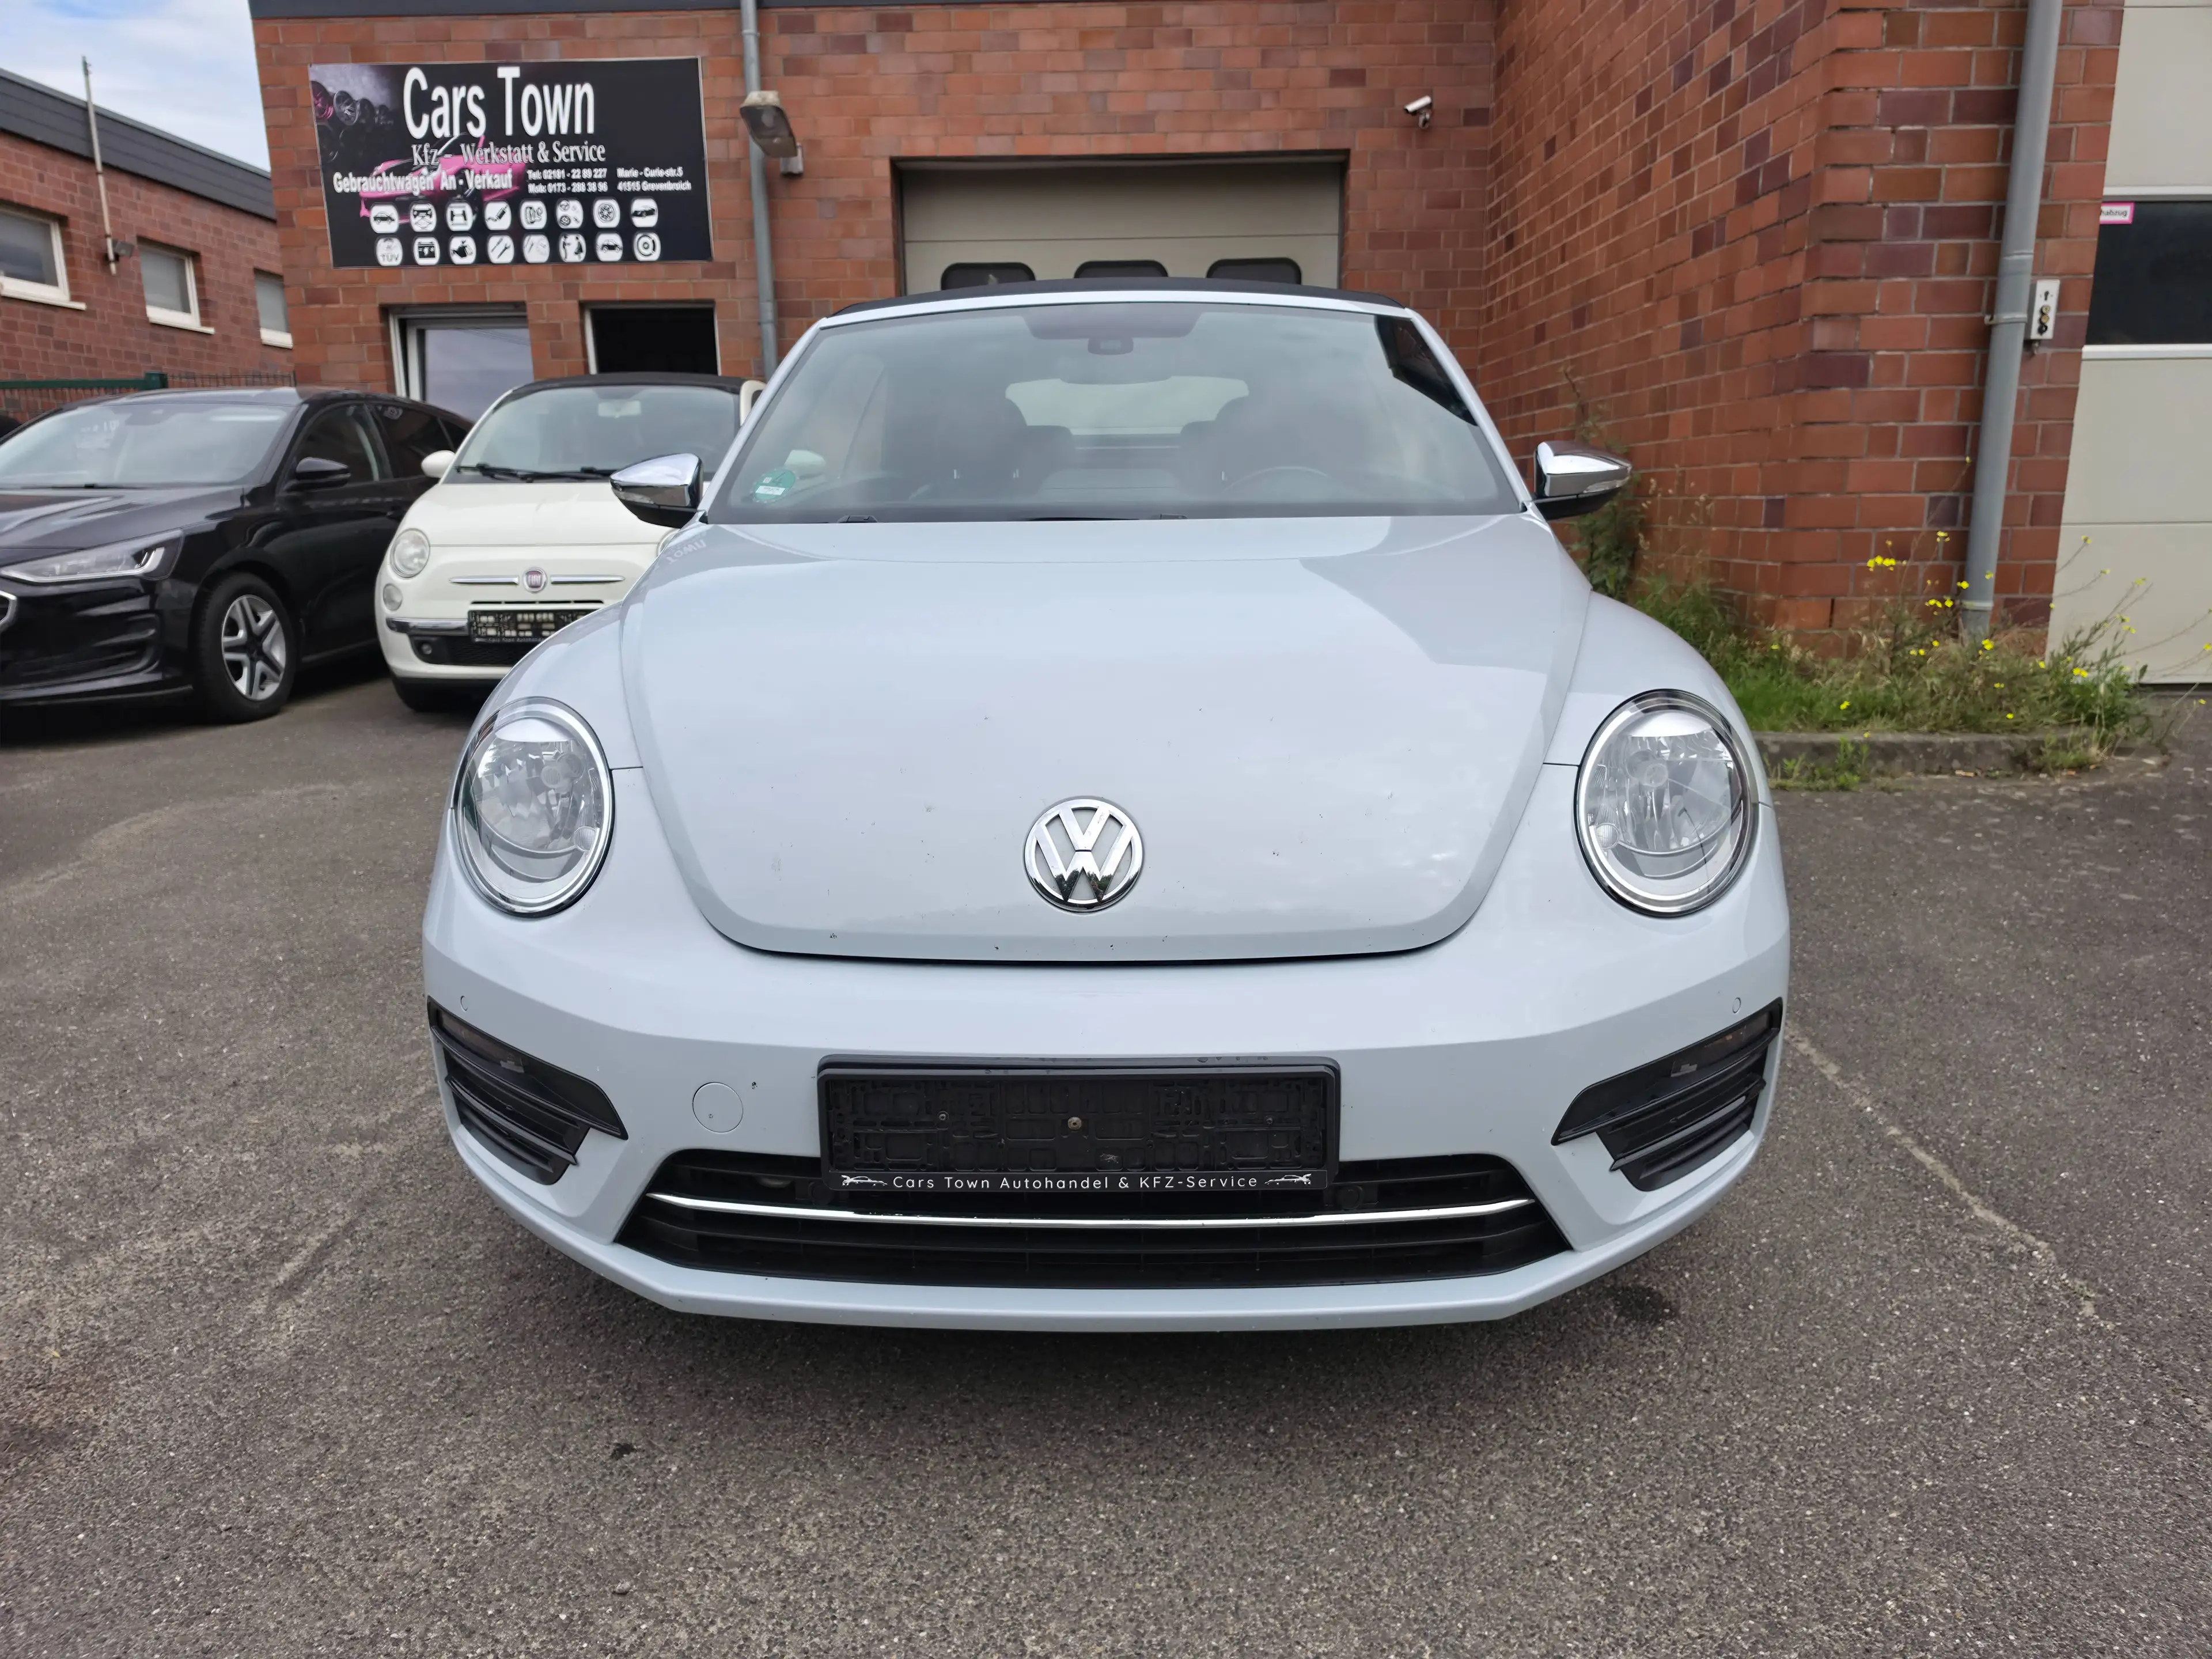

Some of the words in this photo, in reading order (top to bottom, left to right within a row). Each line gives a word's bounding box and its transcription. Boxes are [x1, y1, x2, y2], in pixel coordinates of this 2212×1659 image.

[404, 67, 485, 138] Cars
[497, 66, 594, 136] Town
[412, 143, 439, 166] Kfz
[460, 141, 533, 165] Werkstatt
[537, 142, 550, 162] &
[552, 141, 606, 162] Service
[333, 172, 434, 196] Gebrauchtwagen
[440, 170, 456, 191] An
[465, 168, 513, 190] Verkauf
[893, 1176, 934, 1188] Cars
[944, 1176, 990, 1189] Town
[1000, 1176, 1108, 1189] Autohandel
[1118, 1176, 1129, 1189] &
[1139, 1175, 1257, 1189] KFZ-Service
